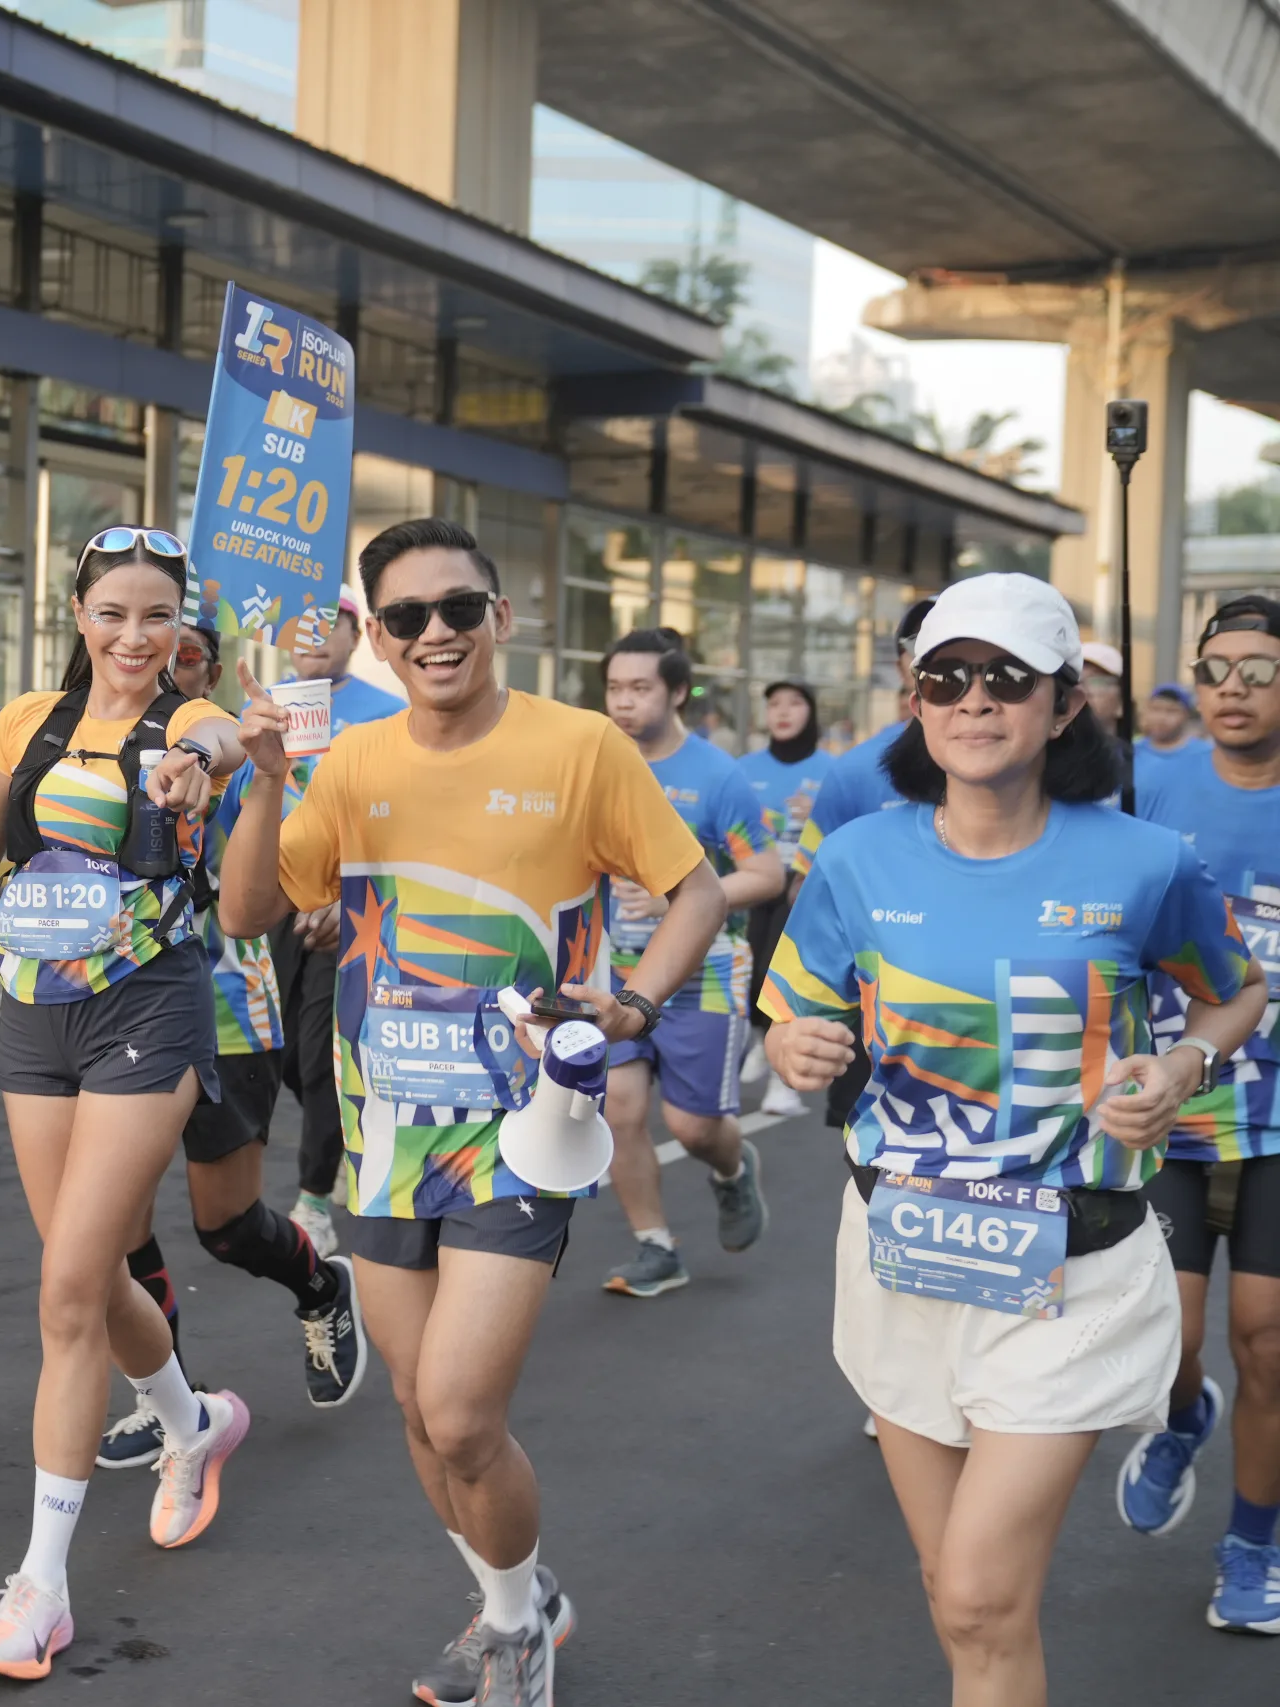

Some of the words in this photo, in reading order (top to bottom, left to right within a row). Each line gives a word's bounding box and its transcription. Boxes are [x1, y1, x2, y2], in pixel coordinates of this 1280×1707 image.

[237, 349, 267, 367] SERIES
[302, 330, 346, 367] ISOPLUS
[298, 349, 346, 398] RUN
[263, 432, 306, 464] SUB
[217, 454, 328, 534] 1:20
[231, 520, 281, 545] UNLOCK
[281, 533, 311, 555] YOUR
[212, 531, 324, 581] GREATNESS
[369, 802, 391, 818] AB
[522, 799, 555, 814] RUN
[84, 858, 111, 874] 10K
[3, 883, 47, 908] SUB
[52, 884, 107, 909] 1:20
[38, 919, 60, 927] PACER
[1083, 911, 1122, 926] RUN
[392, 996, 412, 1005] RUN
[381, 1020, 439, 1050] SUB
[429, 1062, 455, 1071] PACER
[907, 1175, 932, 1190] RUN
[891, 1202, 1039, 1257] C1467
[41, 1495, 80, 1515] PHASE
